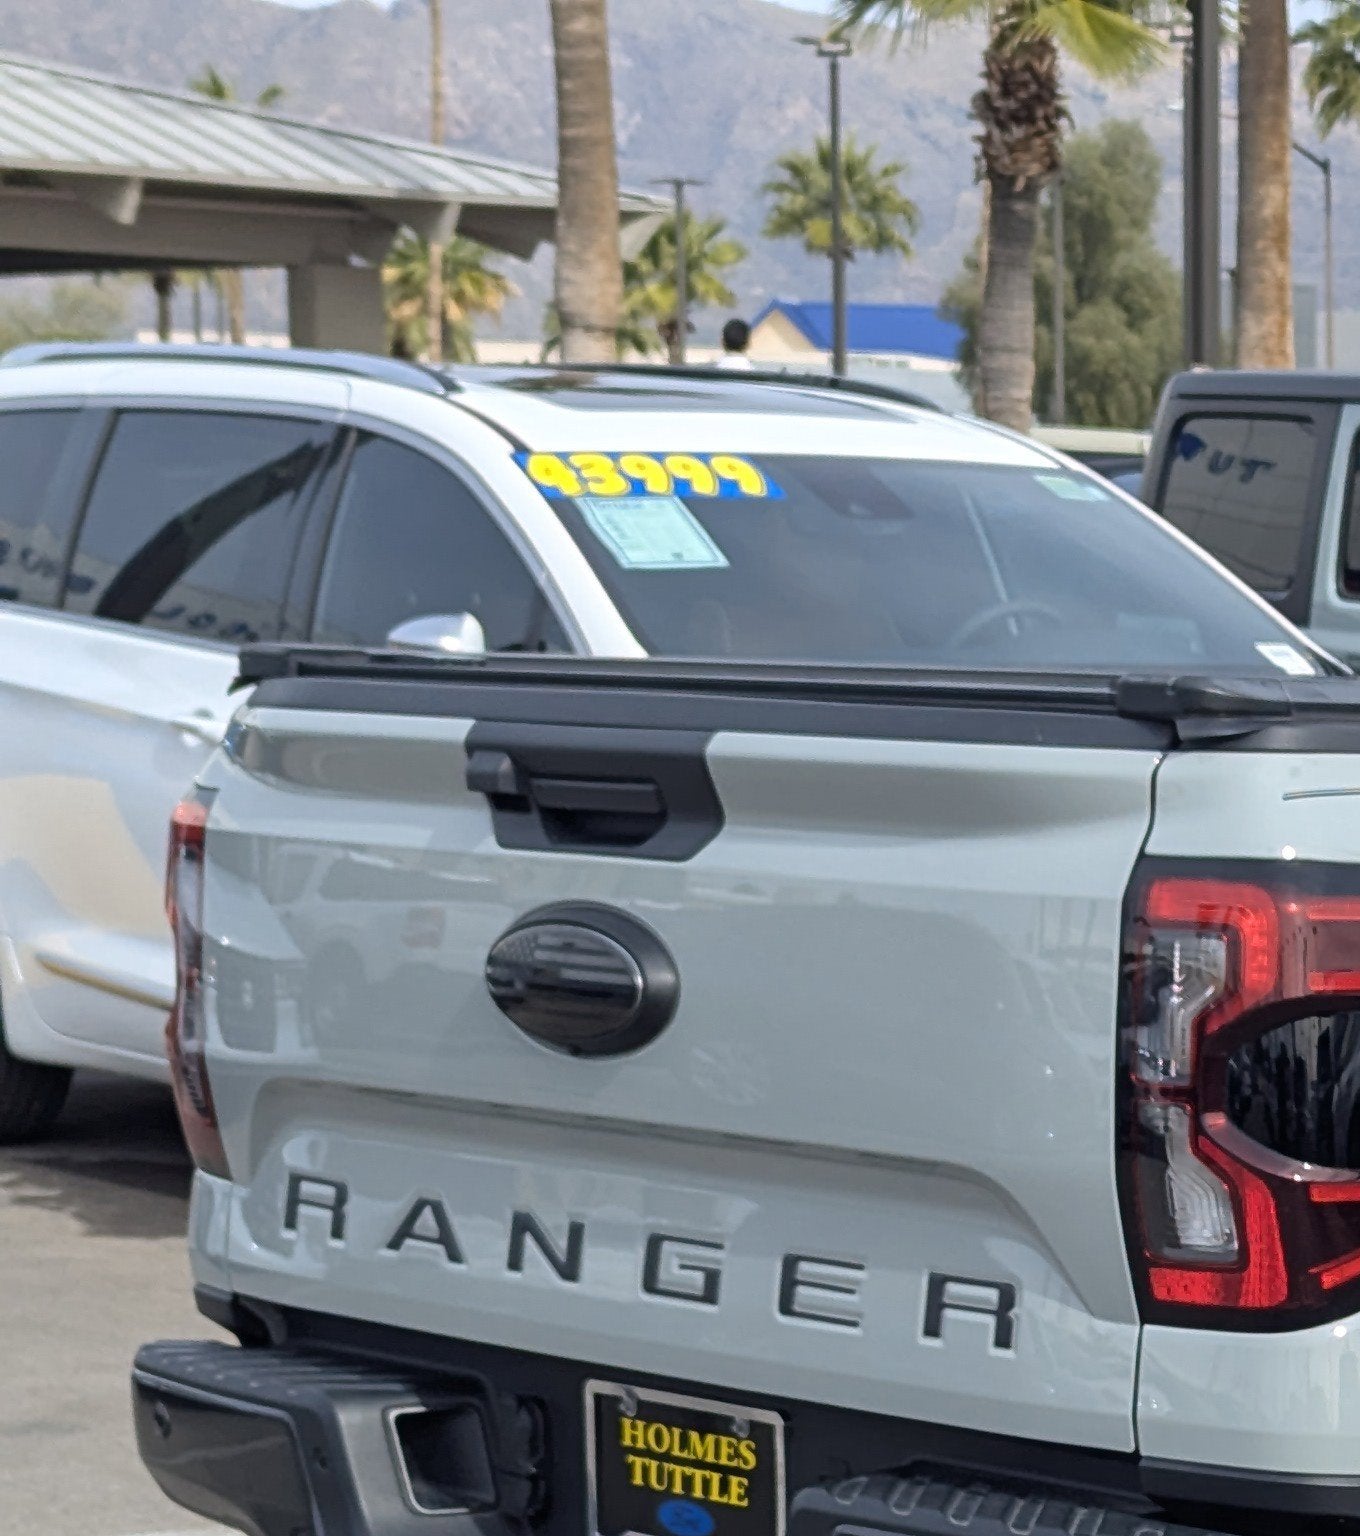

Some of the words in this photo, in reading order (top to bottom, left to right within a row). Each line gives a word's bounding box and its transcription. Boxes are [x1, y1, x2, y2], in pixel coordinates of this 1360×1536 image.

[282, 1172, 1017, 1350] RANGER
[619, 1416, 757, 1471] HOLMES
[625, 1453, 750, 1508] TUTTLE
